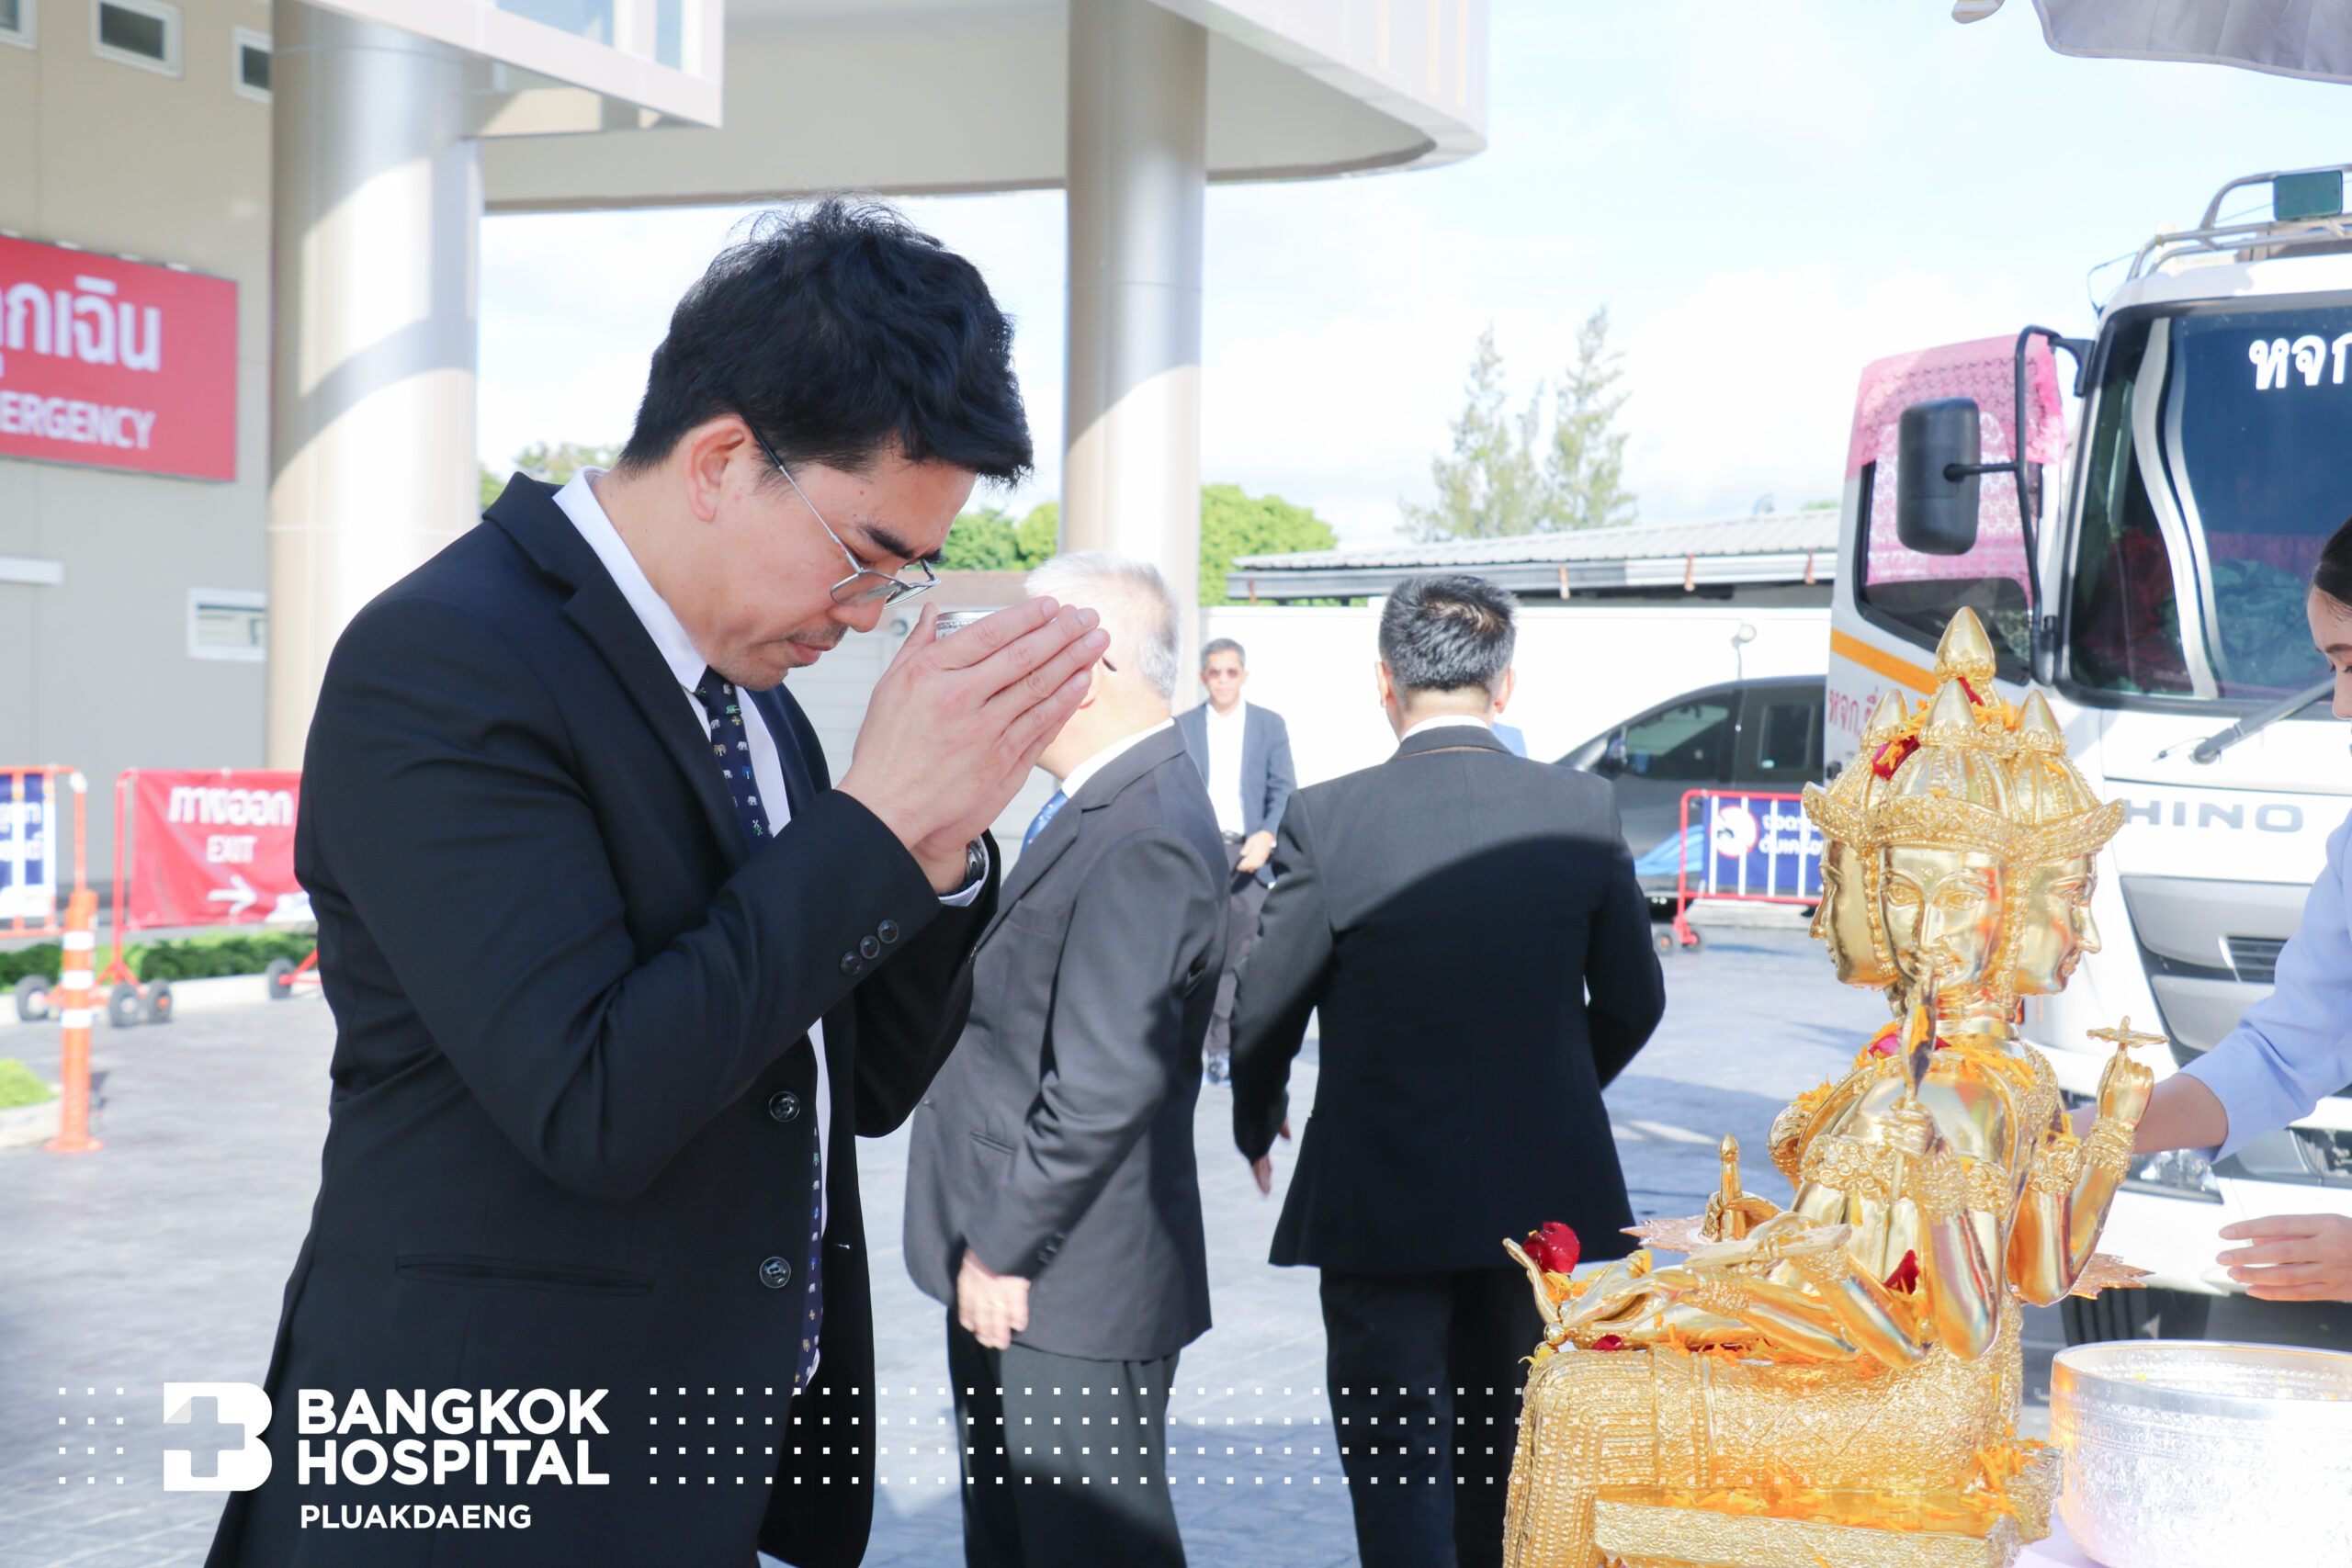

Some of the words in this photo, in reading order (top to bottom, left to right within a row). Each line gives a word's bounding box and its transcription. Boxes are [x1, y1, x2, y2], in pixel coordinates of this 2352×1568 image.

[0, 275, 162, 378] กเฉิน
[0, 389, 157, 451] ERGENCY
[2122, 799, 2303, 832] HINO
[206, 833, 258, 863] EXIT
